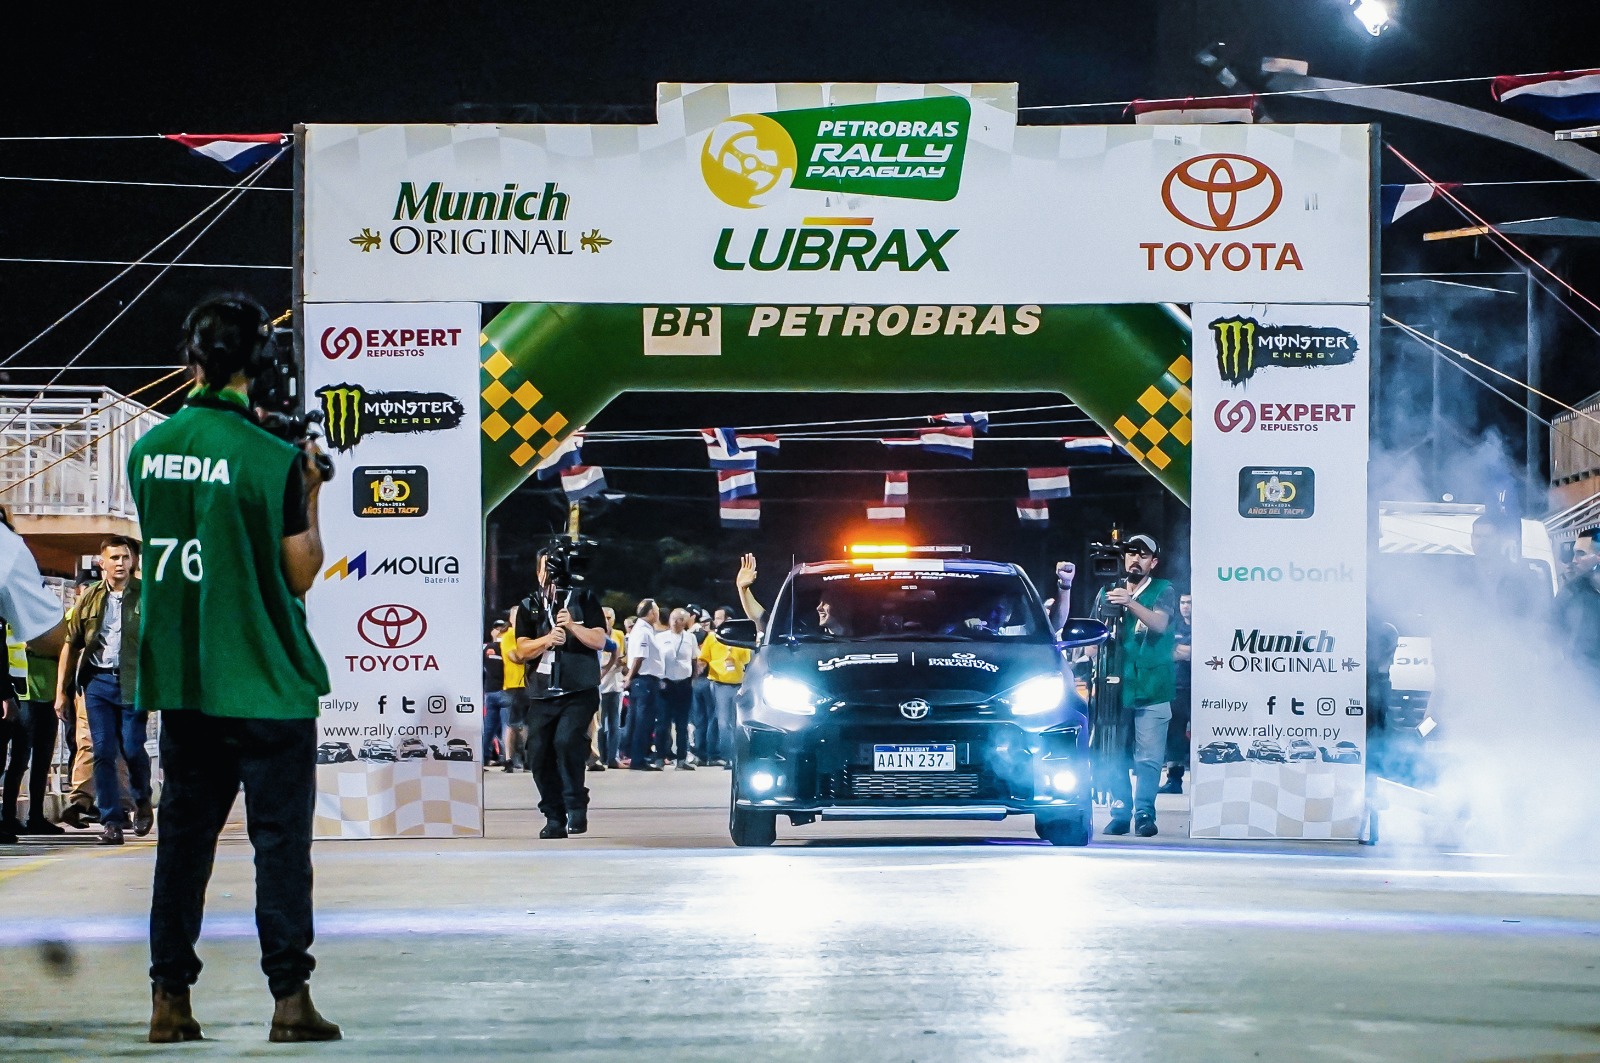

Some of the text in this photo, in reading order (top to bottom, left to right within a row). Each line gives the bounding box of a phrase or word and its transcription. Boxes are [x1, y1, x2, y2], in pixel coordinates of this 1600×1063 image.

[816, 120, 960, 137] PETROBRAS
[810, 143, 954, 163] RALLY
[806, 166, 946, 178] PARAGUAY
[391, 181, 571, 224] Munich
[389, 225, 574, 255] ORIGINAL
[713, 228, 961, 272] LUBRAX
[1139, 241, 1304, 272] TOYOTA
[650, 304, 1042, 337] BR PETROBRAS
[366, 328, 462, 348] EXPERT
[1257, 333, 1350, 351] MONSTER
[366, 348, 425, 358] REPUESTOS
[1272, 351, 1336, 359] ENERGY
[364, 399, 456, 417] MONSTER
[1260, 403, 1356, 422] EXPERT
[378, 417, 442, 425] ENERGY
[1260, 423, 1319, 432] REPUESTOS
[141, 454, 230, 485] MEDIA
[149, 537, 204, 582] 76
[914, 571, 980, 579] PARAGUAY
[1217, 561, 1355, 582] ueno bank
[1230, 628, 1336, 654] Munich
[344, 654, 440, 673] TOYOTA
[1228, 654, 1338, 673] ORIGINAL
[320, 699, 360, 712] rallypy
[1201, 698, 1249, 712] #rallypy
[323, 723, 452, 739] www.rally.com.py
[1211, 724, 1341, 740] www.rally.com.py
[878, 753, 945, 768] AAIN 237
